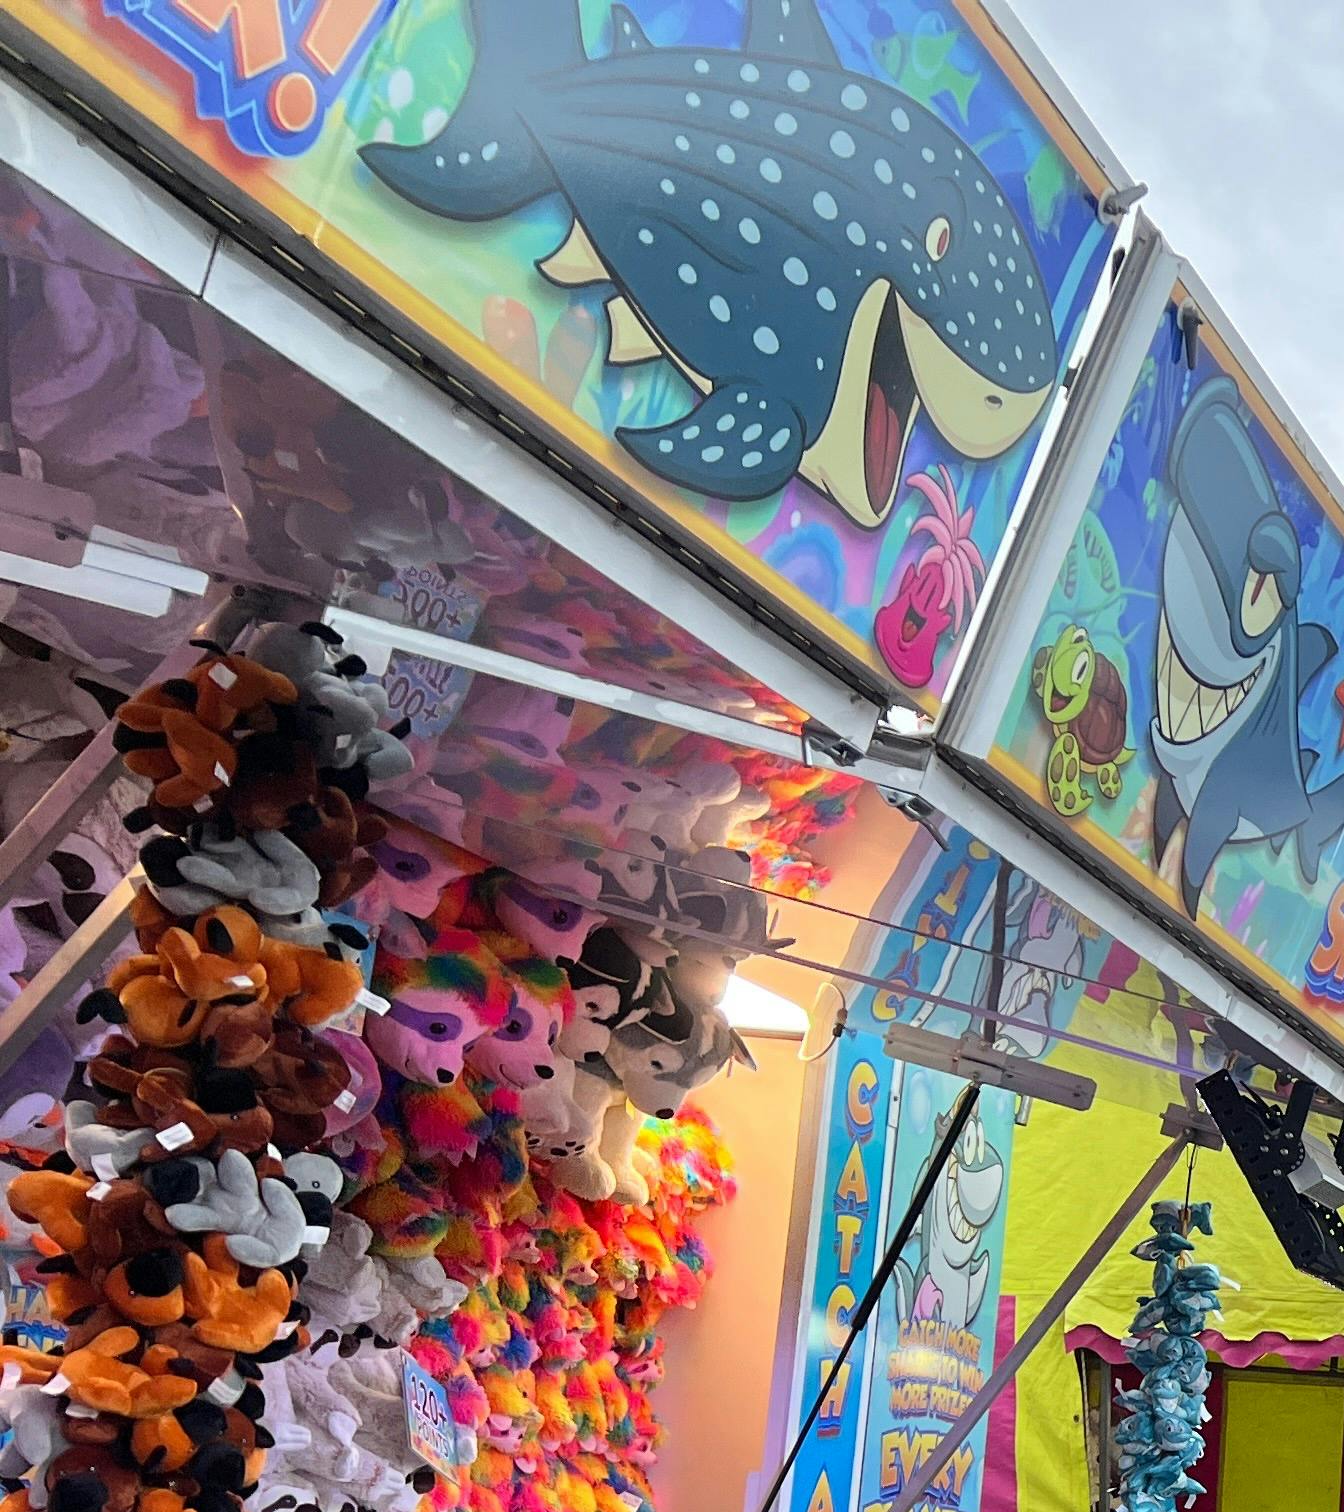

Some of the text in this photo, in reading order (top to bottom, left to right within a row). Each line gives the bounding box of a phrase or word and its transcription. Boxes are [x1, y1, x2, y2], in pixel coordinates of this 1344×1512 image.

[818, 1059, 879, 1428] CATCH
[899, 1319, 982, 1363] CATCH MORE
[410, 1374, 448, 1427] 120+
[890, 1382, 929, 1412] MORE
[415, 1415, 450, 1459] POINTS
